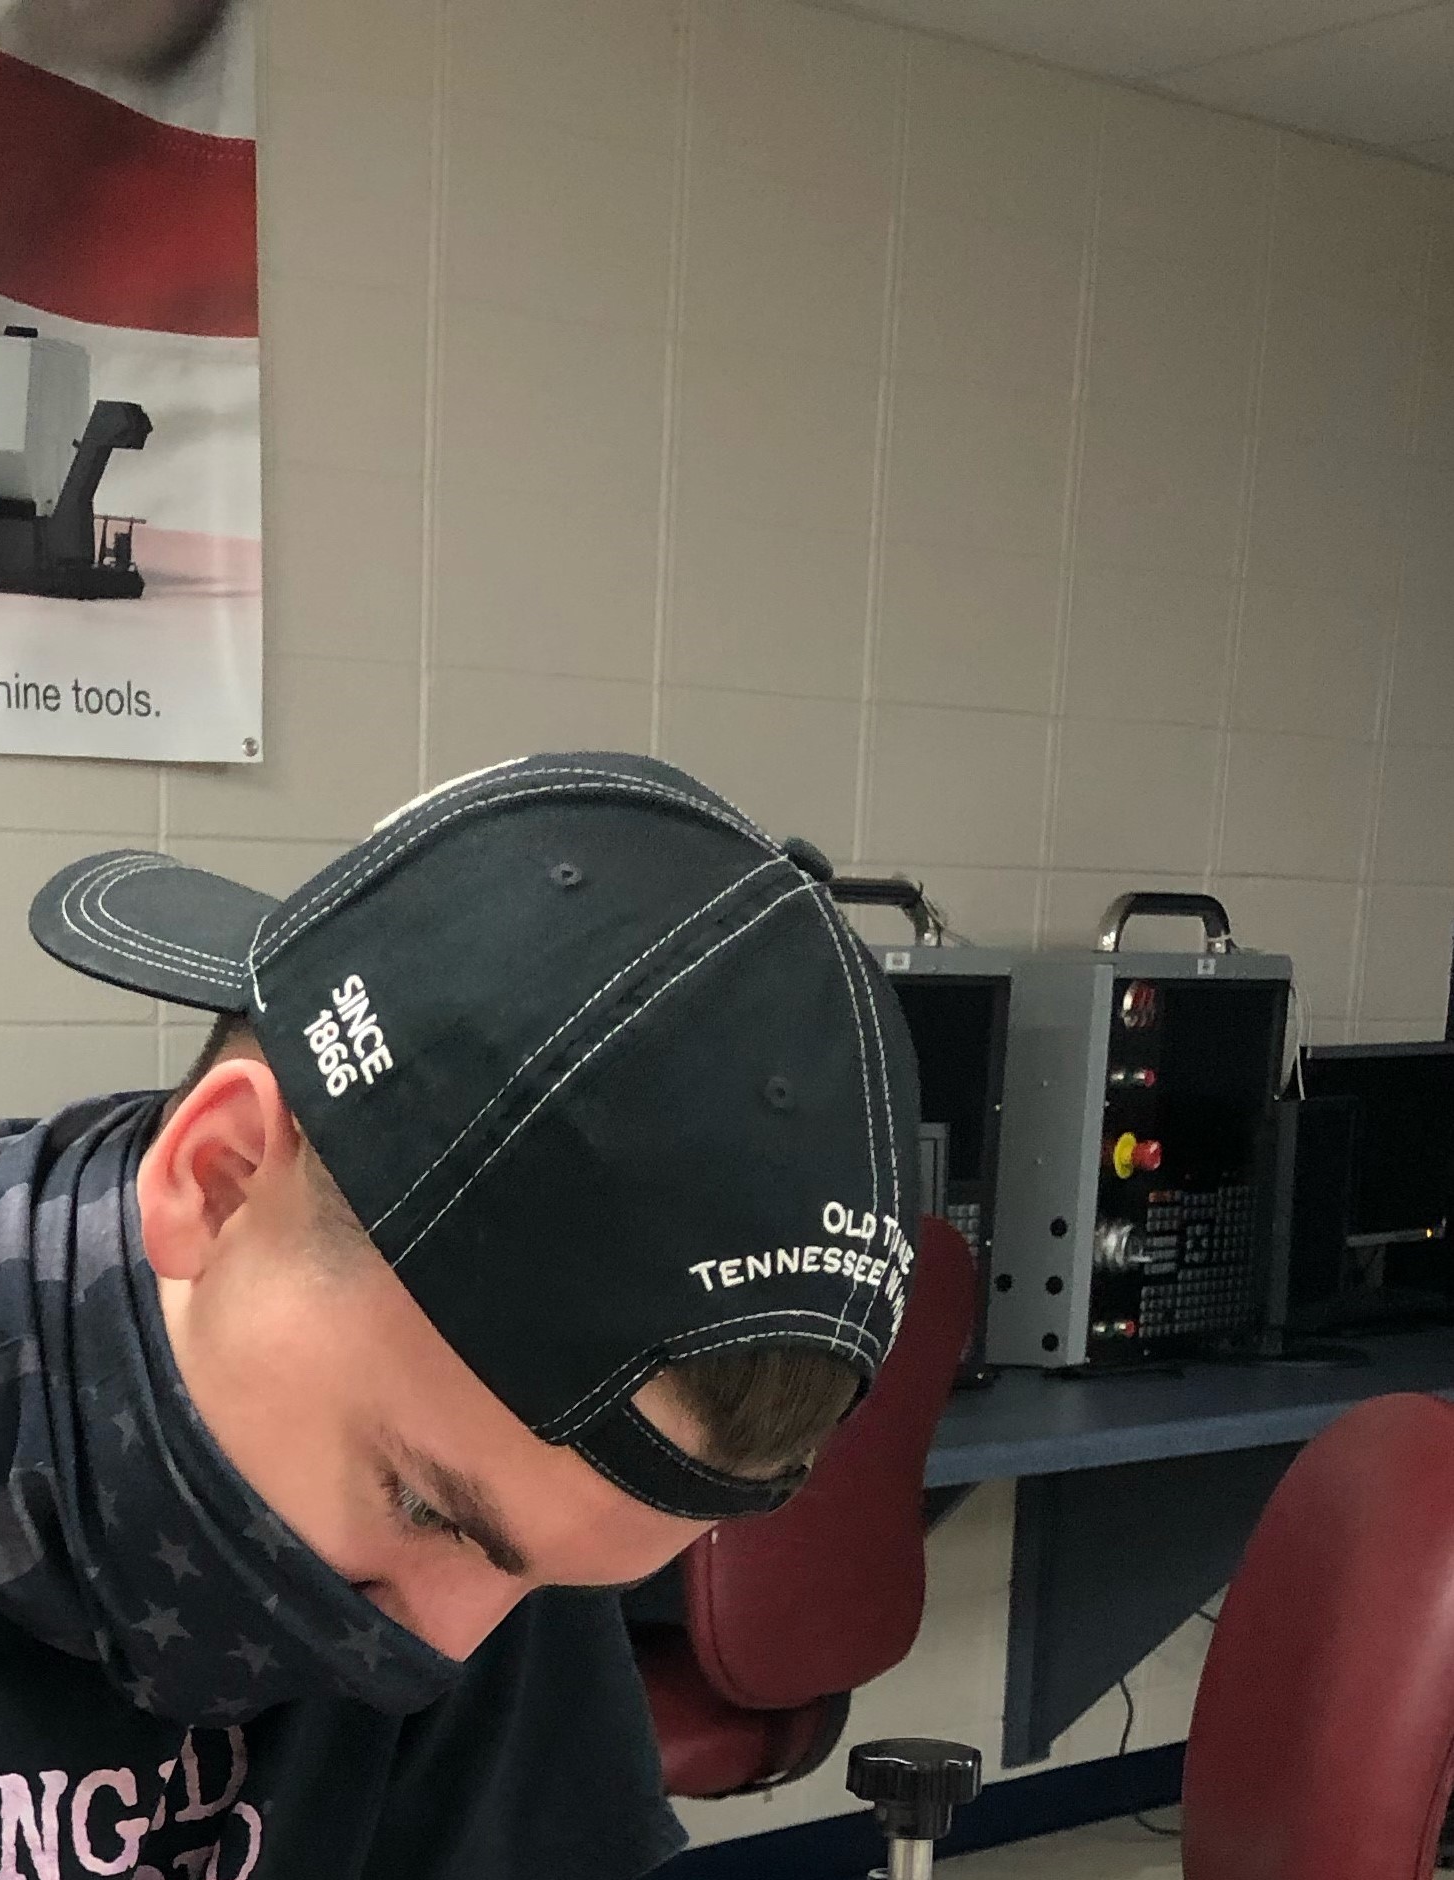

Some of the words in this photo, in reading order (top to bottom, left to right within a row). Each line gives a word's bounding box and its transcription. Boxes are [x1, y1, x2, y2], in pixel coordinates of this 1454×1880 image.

[72, 678, 161, 718] tools.
[332, 974, 394, 1085] SINCE
[303, 1009, 358, 1097] 1866
[823, 1201, 878, 1240] OLD
[688, 1246, 887, 1292] TENNESSEE
